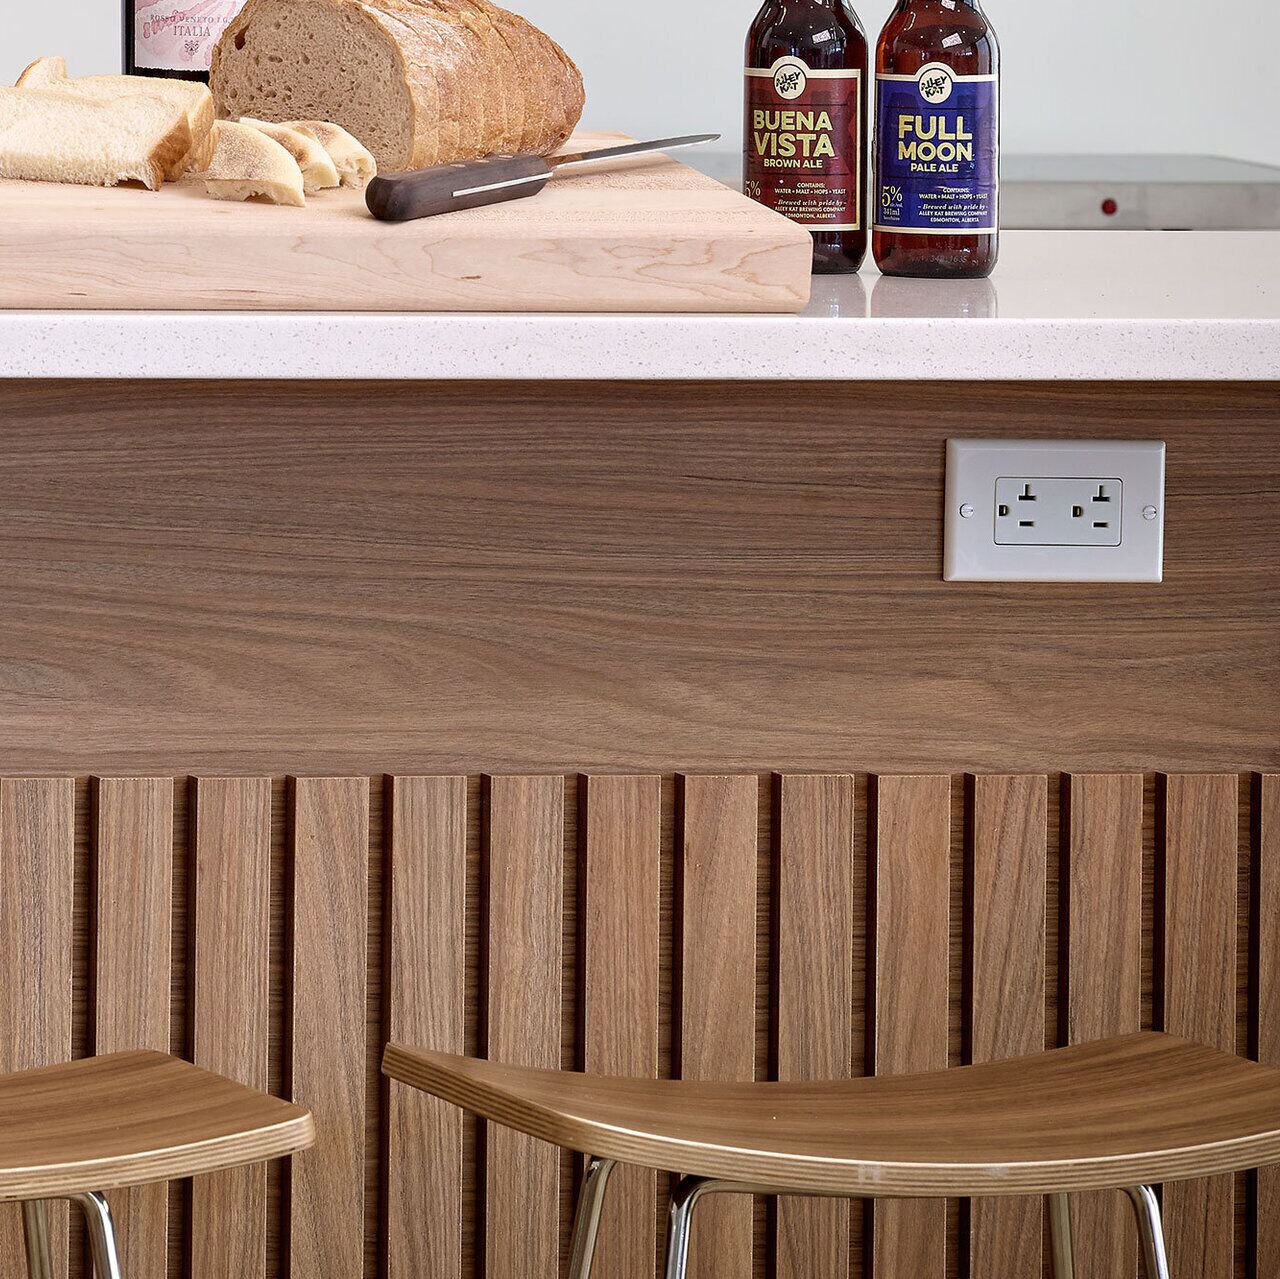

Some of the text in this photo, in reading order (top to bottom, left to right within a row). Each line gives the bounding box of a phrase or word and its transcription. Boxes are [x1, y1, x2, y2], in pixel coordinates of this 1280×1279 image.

[150, 14, 176, 23] ROSSO
[179, 15, 214, 24] VENETO
[173, 25, 211, 37] ITALIA
[776, 71, 801, 87] ALLEY
[920, 76, 947, 91] ALLEY
[779, 82, 799, 94] KAT
[925, 86, 945, 98] KAT
[753, 109, 833, 131] BUENA
[898, 114, 973, 140] FULL
[753, 131, 836, 158] VISTA
[898, 140, 973, 162] MOON
[763, 159, 823, 168] BROWN ALE
[910, 163, 959, 173] PALE ALE
[881, 185, 903, 207] 5%
